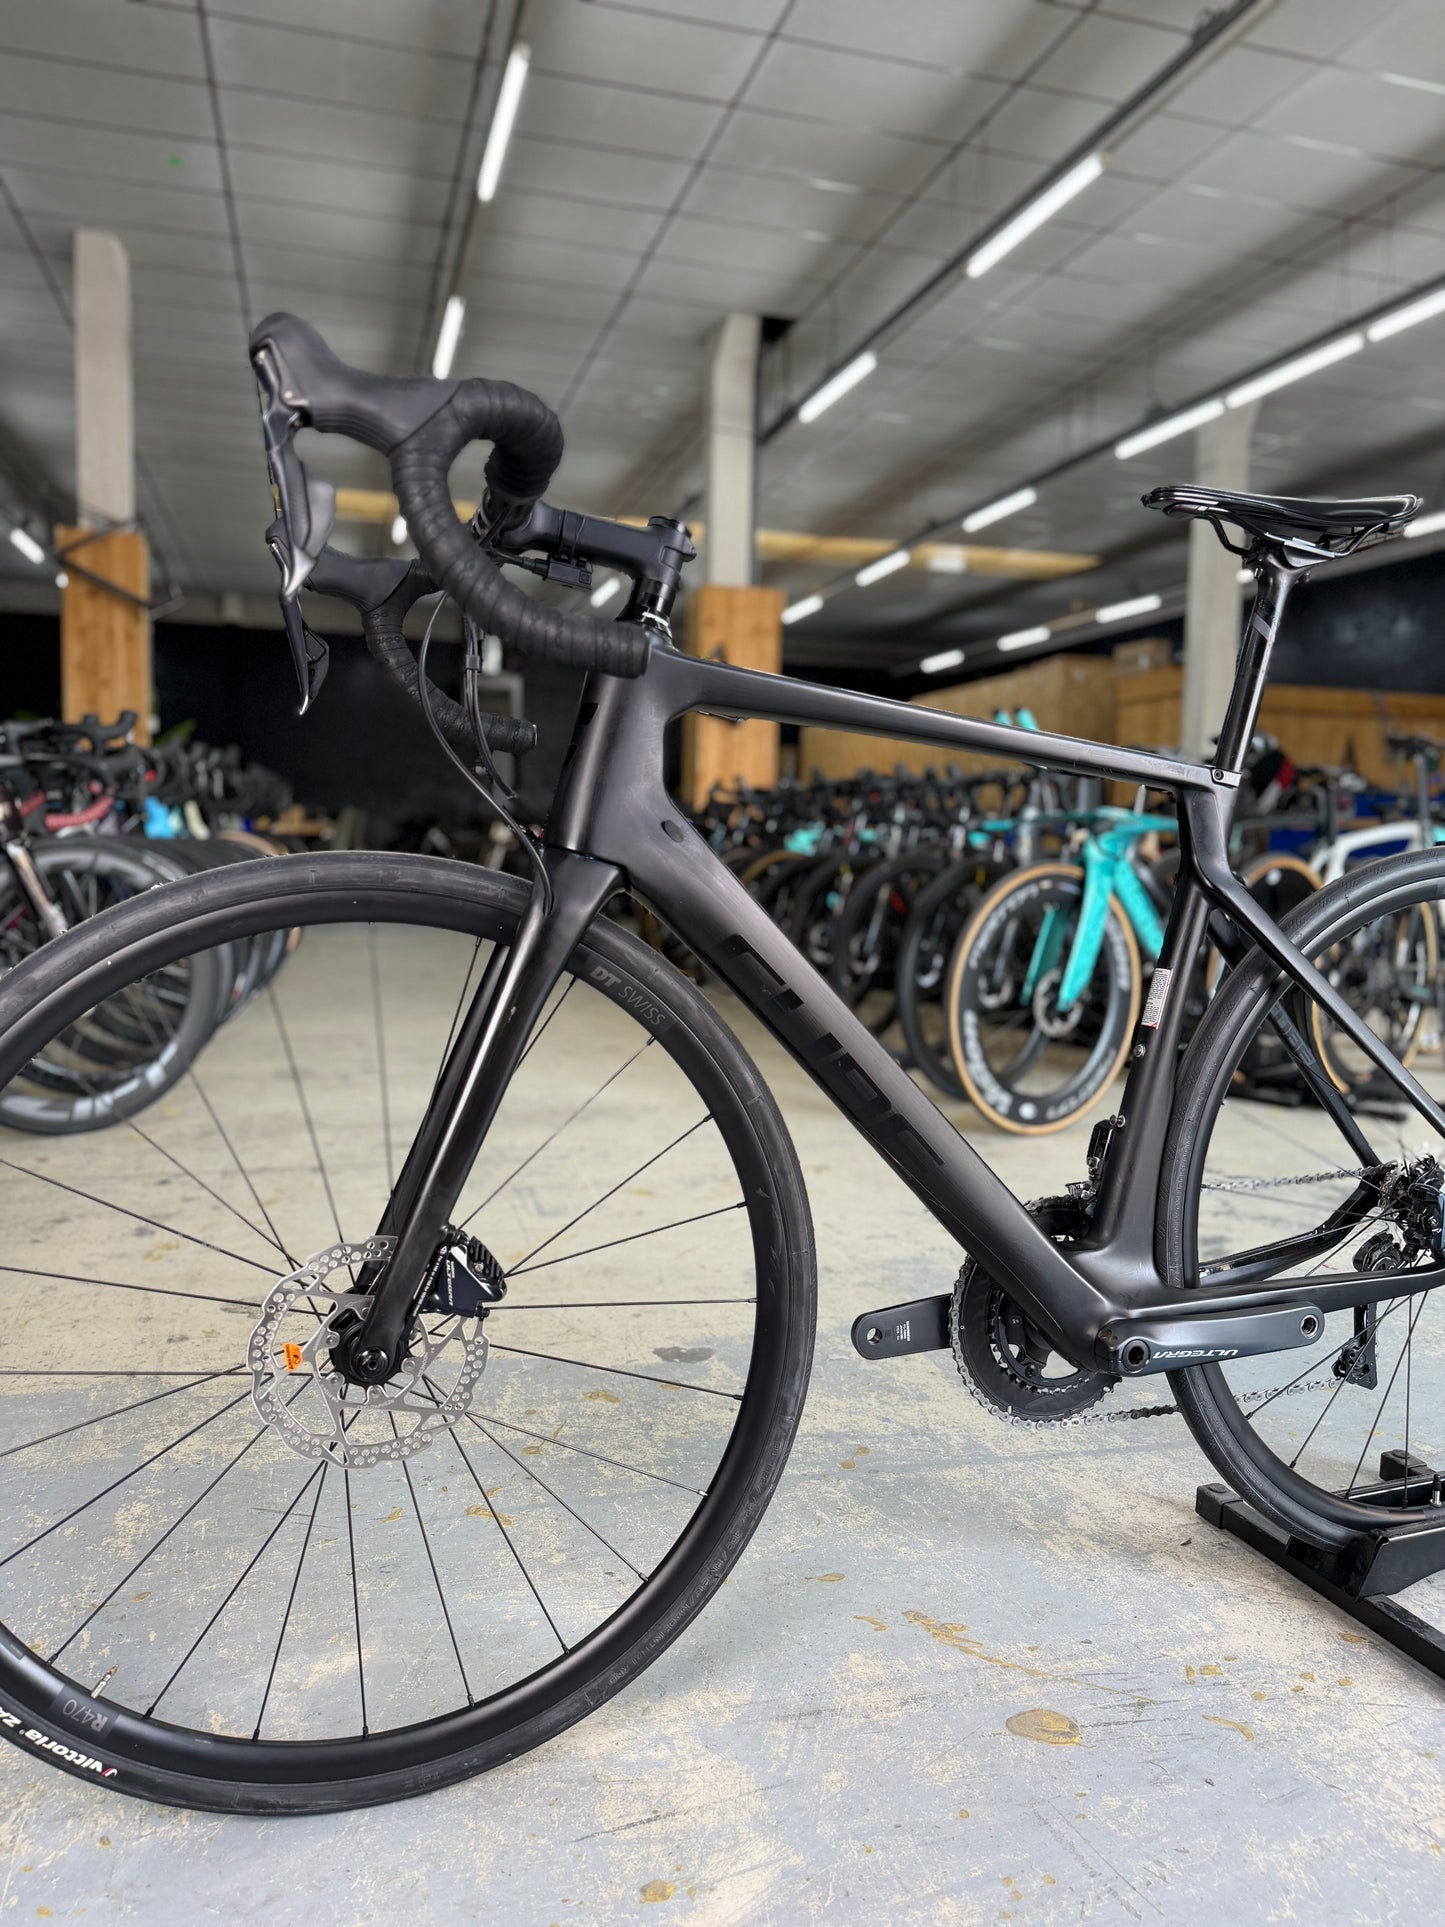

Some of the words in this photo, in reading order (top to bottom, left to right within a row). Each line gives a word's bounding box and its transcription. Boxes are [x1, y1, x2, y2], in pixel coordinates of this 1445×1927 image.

[589, 965, 622, 988] DT
[617, 985, 667, 1026] SWISS
[1152, 1348, 1239, 1360] ULTEGRA
[62, 1698, 109, 1733] R470
[24, 1728, 103, 1774] vittoria
